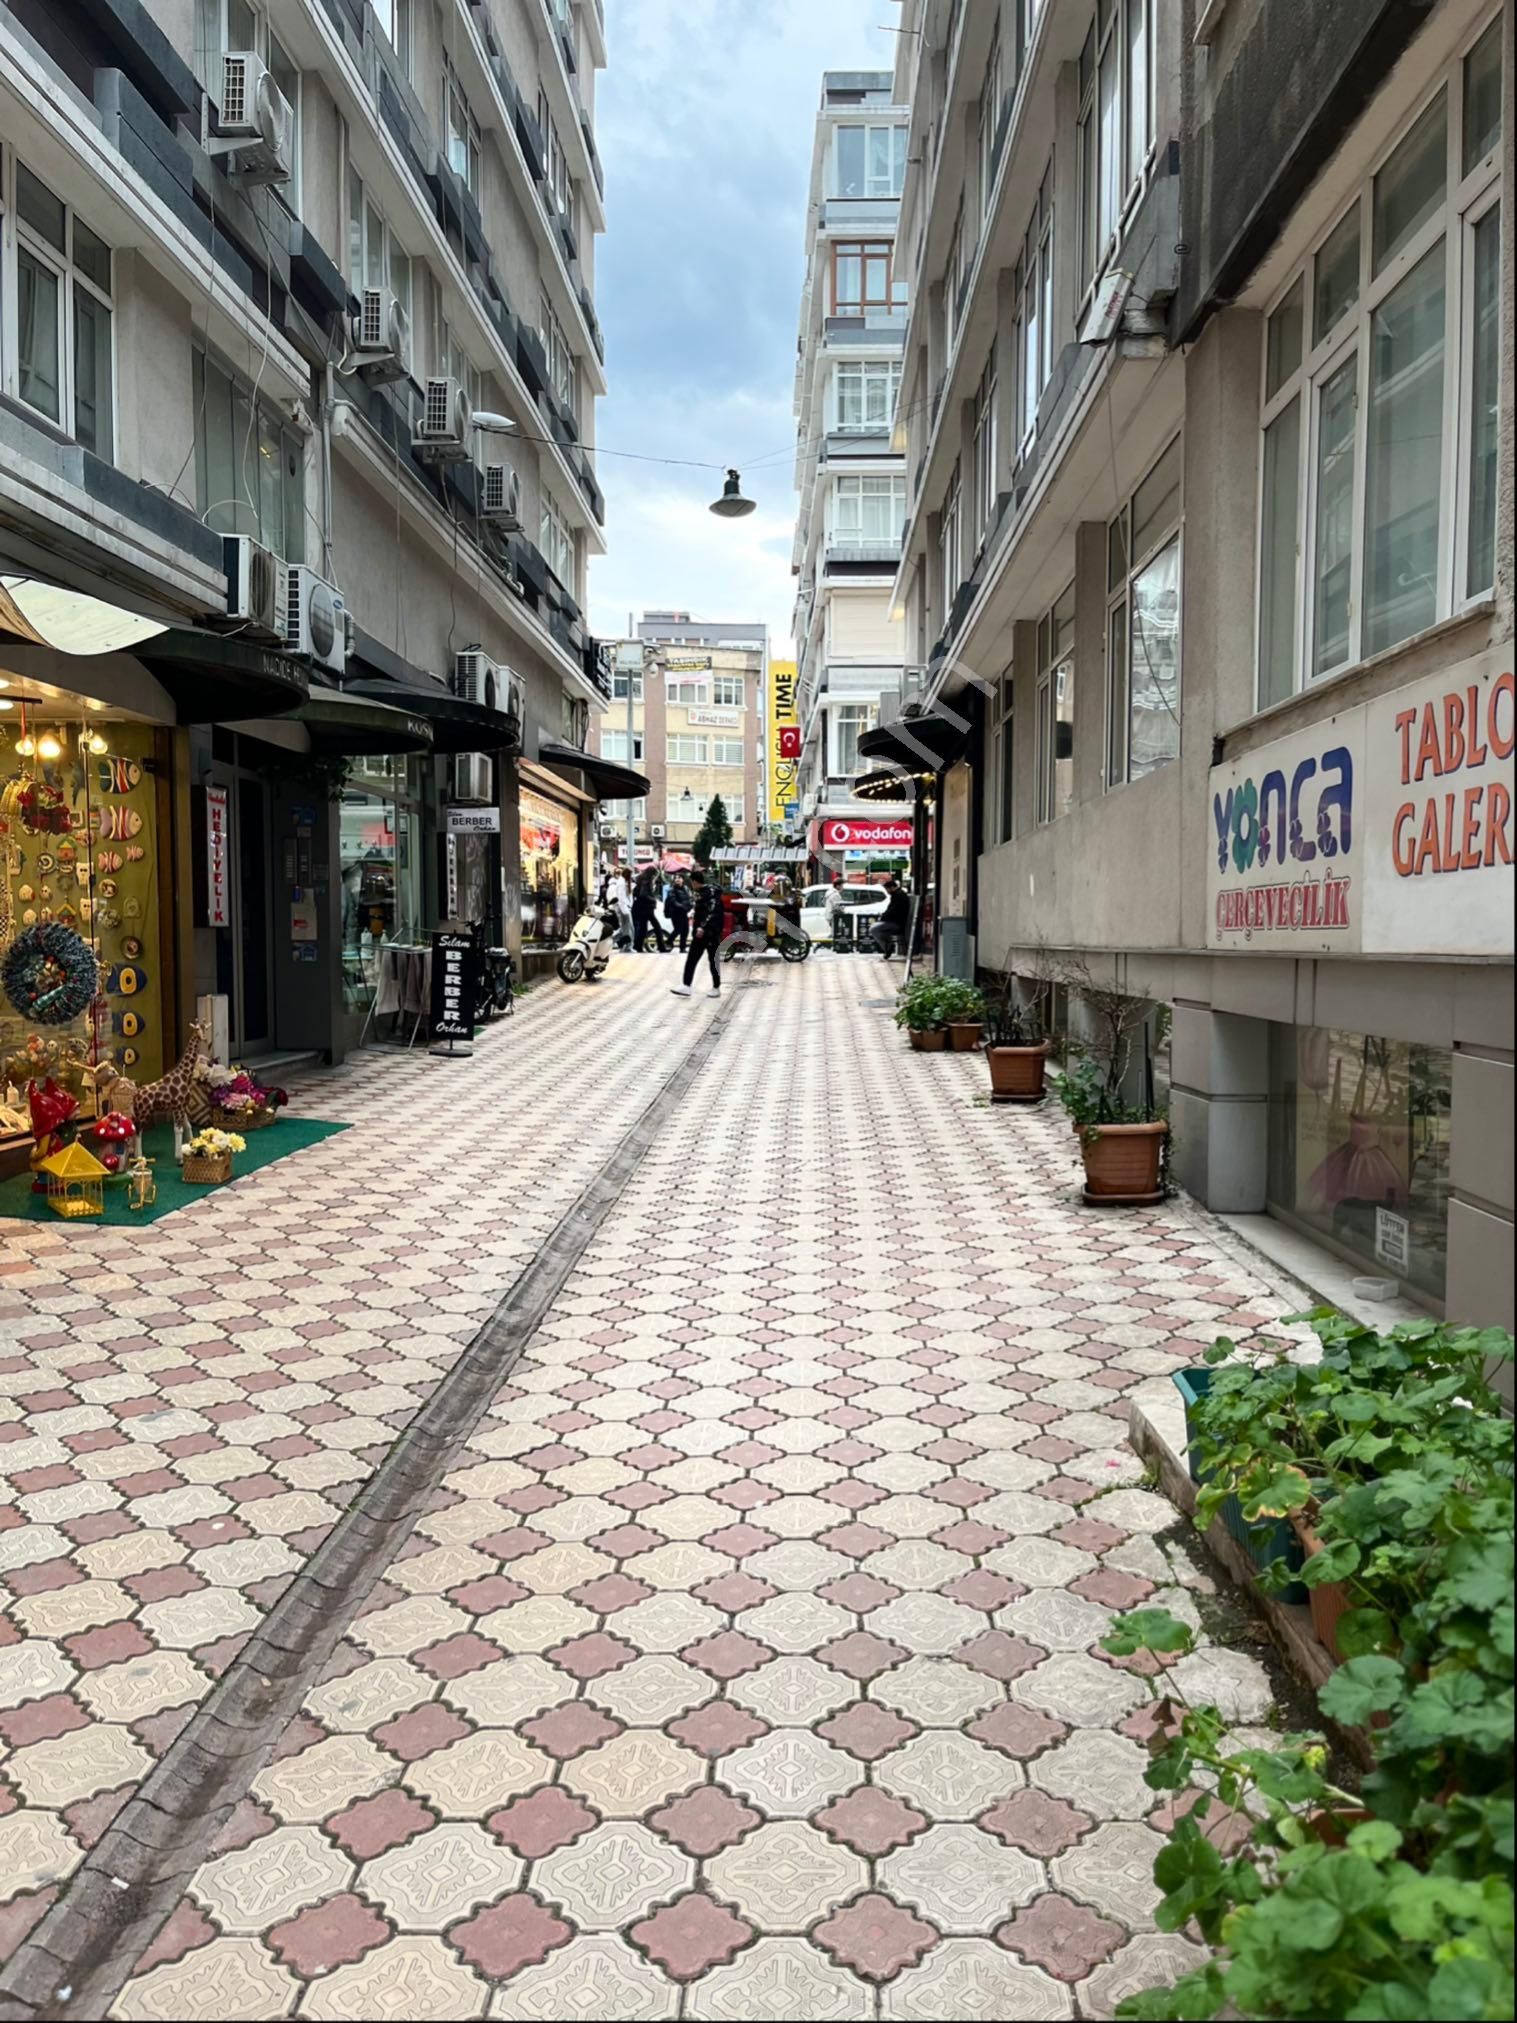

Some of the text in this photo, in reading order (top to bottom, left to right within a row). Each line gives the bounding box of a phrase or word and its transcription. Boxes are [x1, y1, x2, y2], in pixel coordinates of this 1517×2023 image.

[775, 674, 792, 720] TIME
[1395, 672, 1513, 785] TABLO
[452, 817, 492, 826] BERBER
[855, 827, 912, 839] vodafon
[1392, 782, 1513, 878] GALER
[1216, 867, 1351, 941] ÇERÇEVECİLİK
[443, 950, 462, 1020] BERBER
[435, 1021, 468, 1034] Orhan
